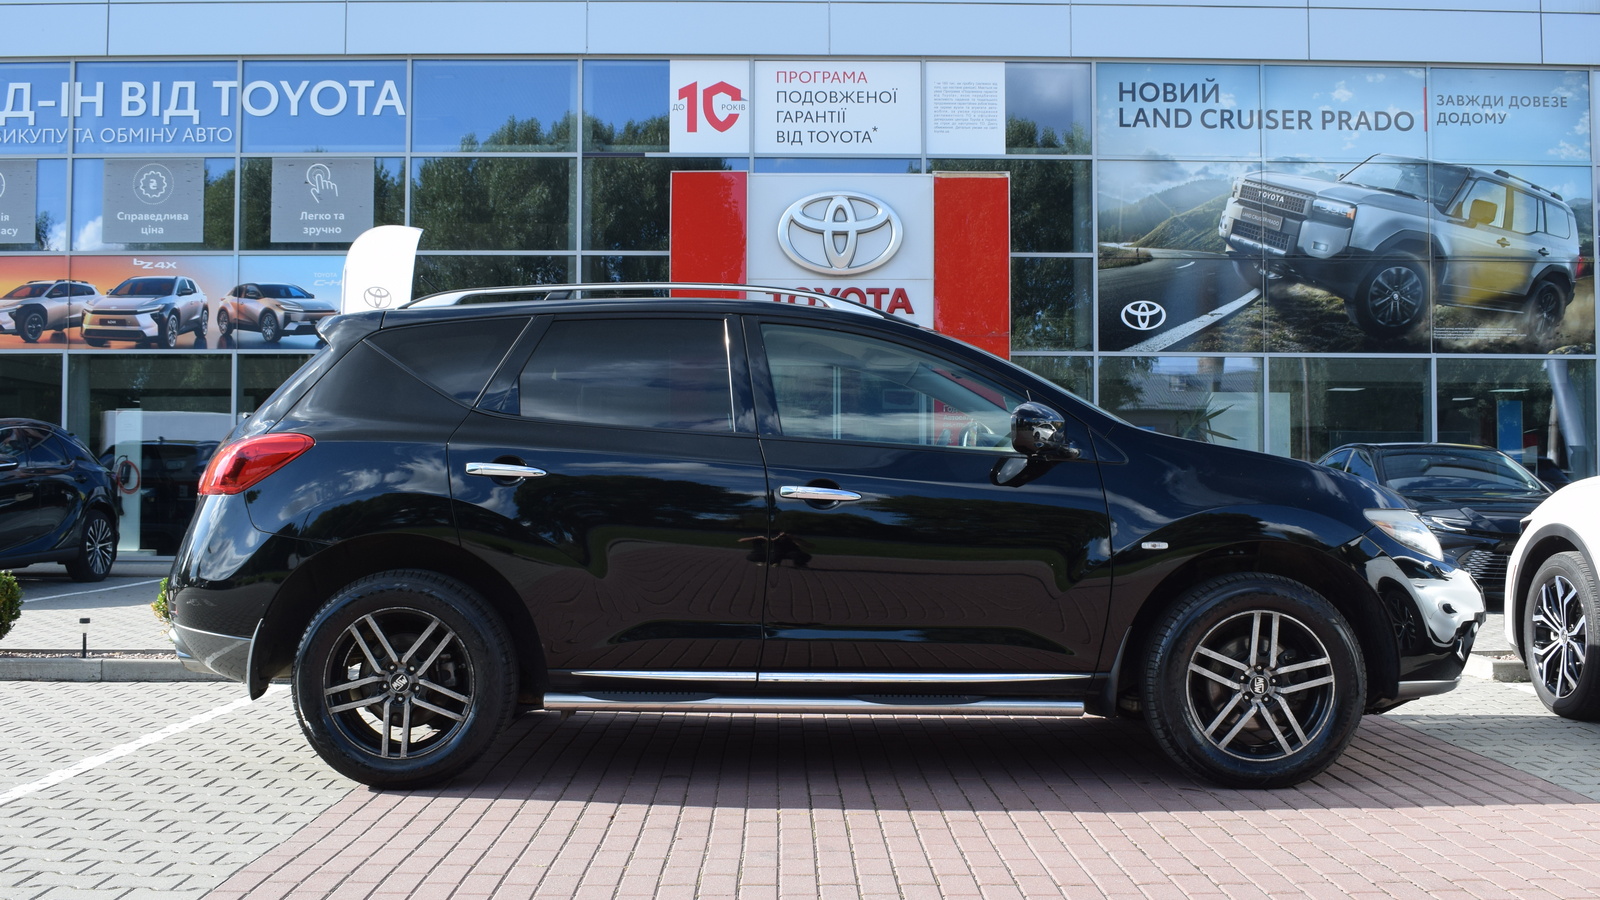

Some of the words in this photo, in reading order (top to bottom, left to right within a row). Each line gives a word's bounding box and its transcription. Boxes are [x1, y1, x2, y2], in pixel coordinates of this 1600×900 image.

[776, 71, 868, 83] ПРОГРАМА
[776, 88, 898, 106] ПОДОВЖЕНОЇ
[1118, 78, 1219, 103] НОВИЙ
[121, 81, 200, 125] ВІД
[212, 79, 406, 117] TOYOTA
[1436, 94, 1504, 109] ЗАВЖДИ
[1508, 96, 1568, 109] ДОВЕЗЕ
[776, 108, 847, 123] ГАРАНТІЇ
[1119, 107, 1193, 129] LAND
[1200, 108, 1314, 130] CRUISER
[1321, 110, 1415, 132] PRADO
[1436, 112, 1507, 126] ДОДОМУ
[0, 128, 68, 144] ИКУПУ
[73, 128, 95, 143] ТА
[100, 127, 177, 143] ОБМІНУ
[182, 127, 233, 143] АВТО
[776, 130, 803, 146] ВІД
[1258, 191, 1285, 203] TOYOTA
[116, 211, 189, 222] Справедлива
[300, 211, 331, 220] Легко
[141, 225, 164, 235] ціна
[303, 226, 342, 236] зручно
